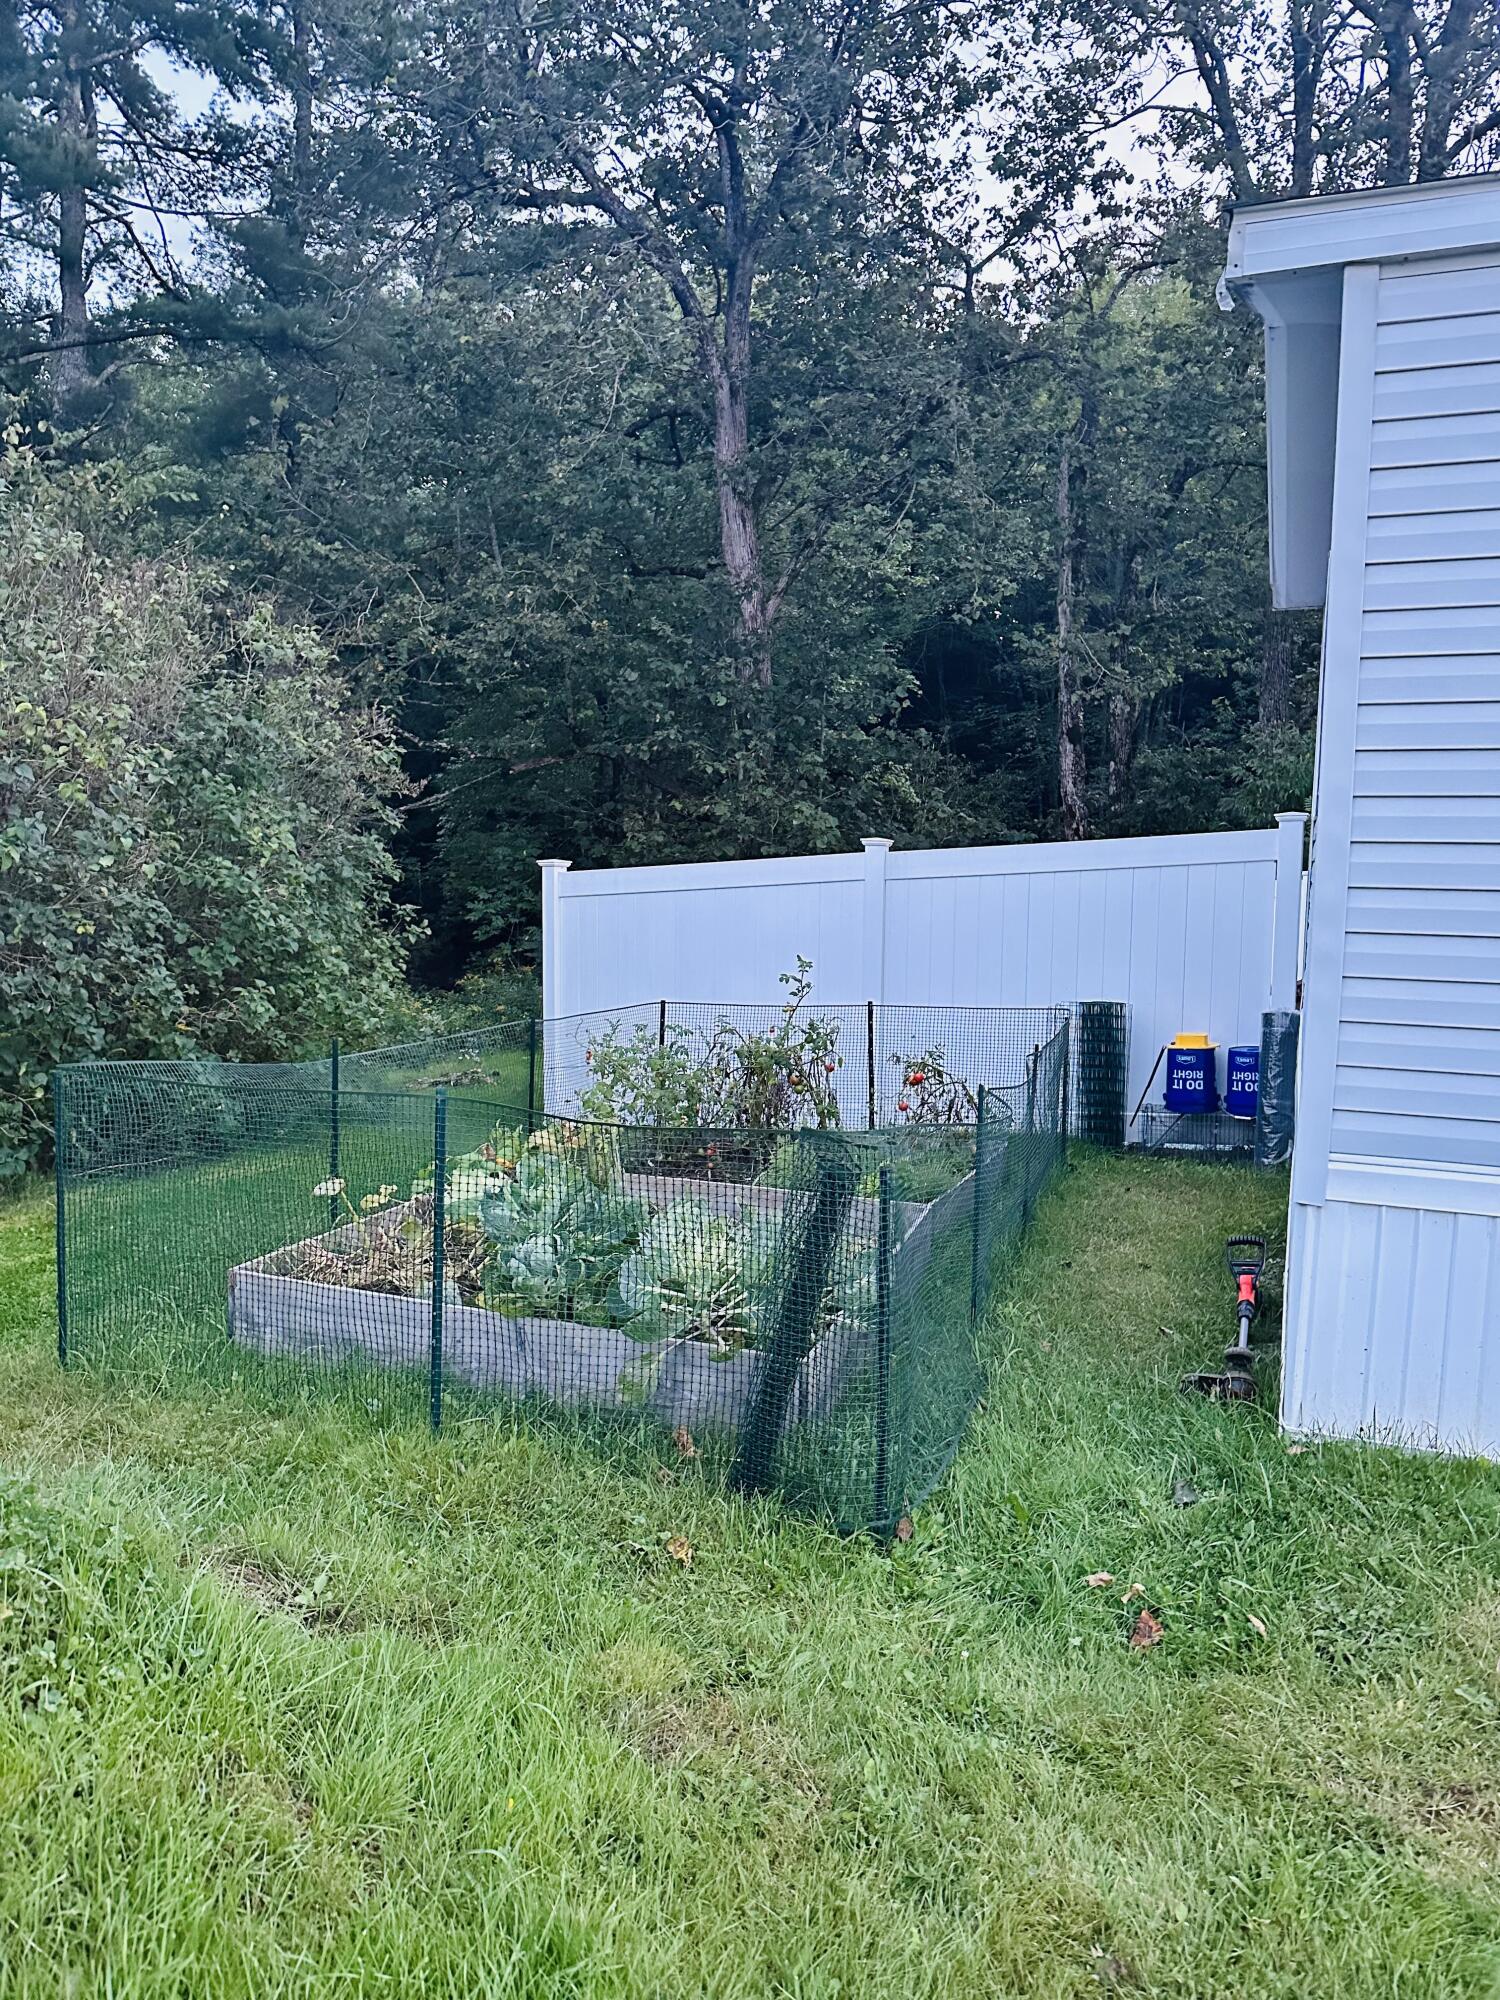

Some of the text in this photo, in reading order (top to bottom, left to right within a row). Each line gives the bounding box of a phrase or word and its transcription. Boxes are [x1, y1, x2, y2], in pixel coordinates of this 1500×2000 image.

[1172, 1069, 1203, 1079] RIGHT
[1172, 1079, 1203, 1090] DO IT
[1232, 1081, 1242, 1092] IT
